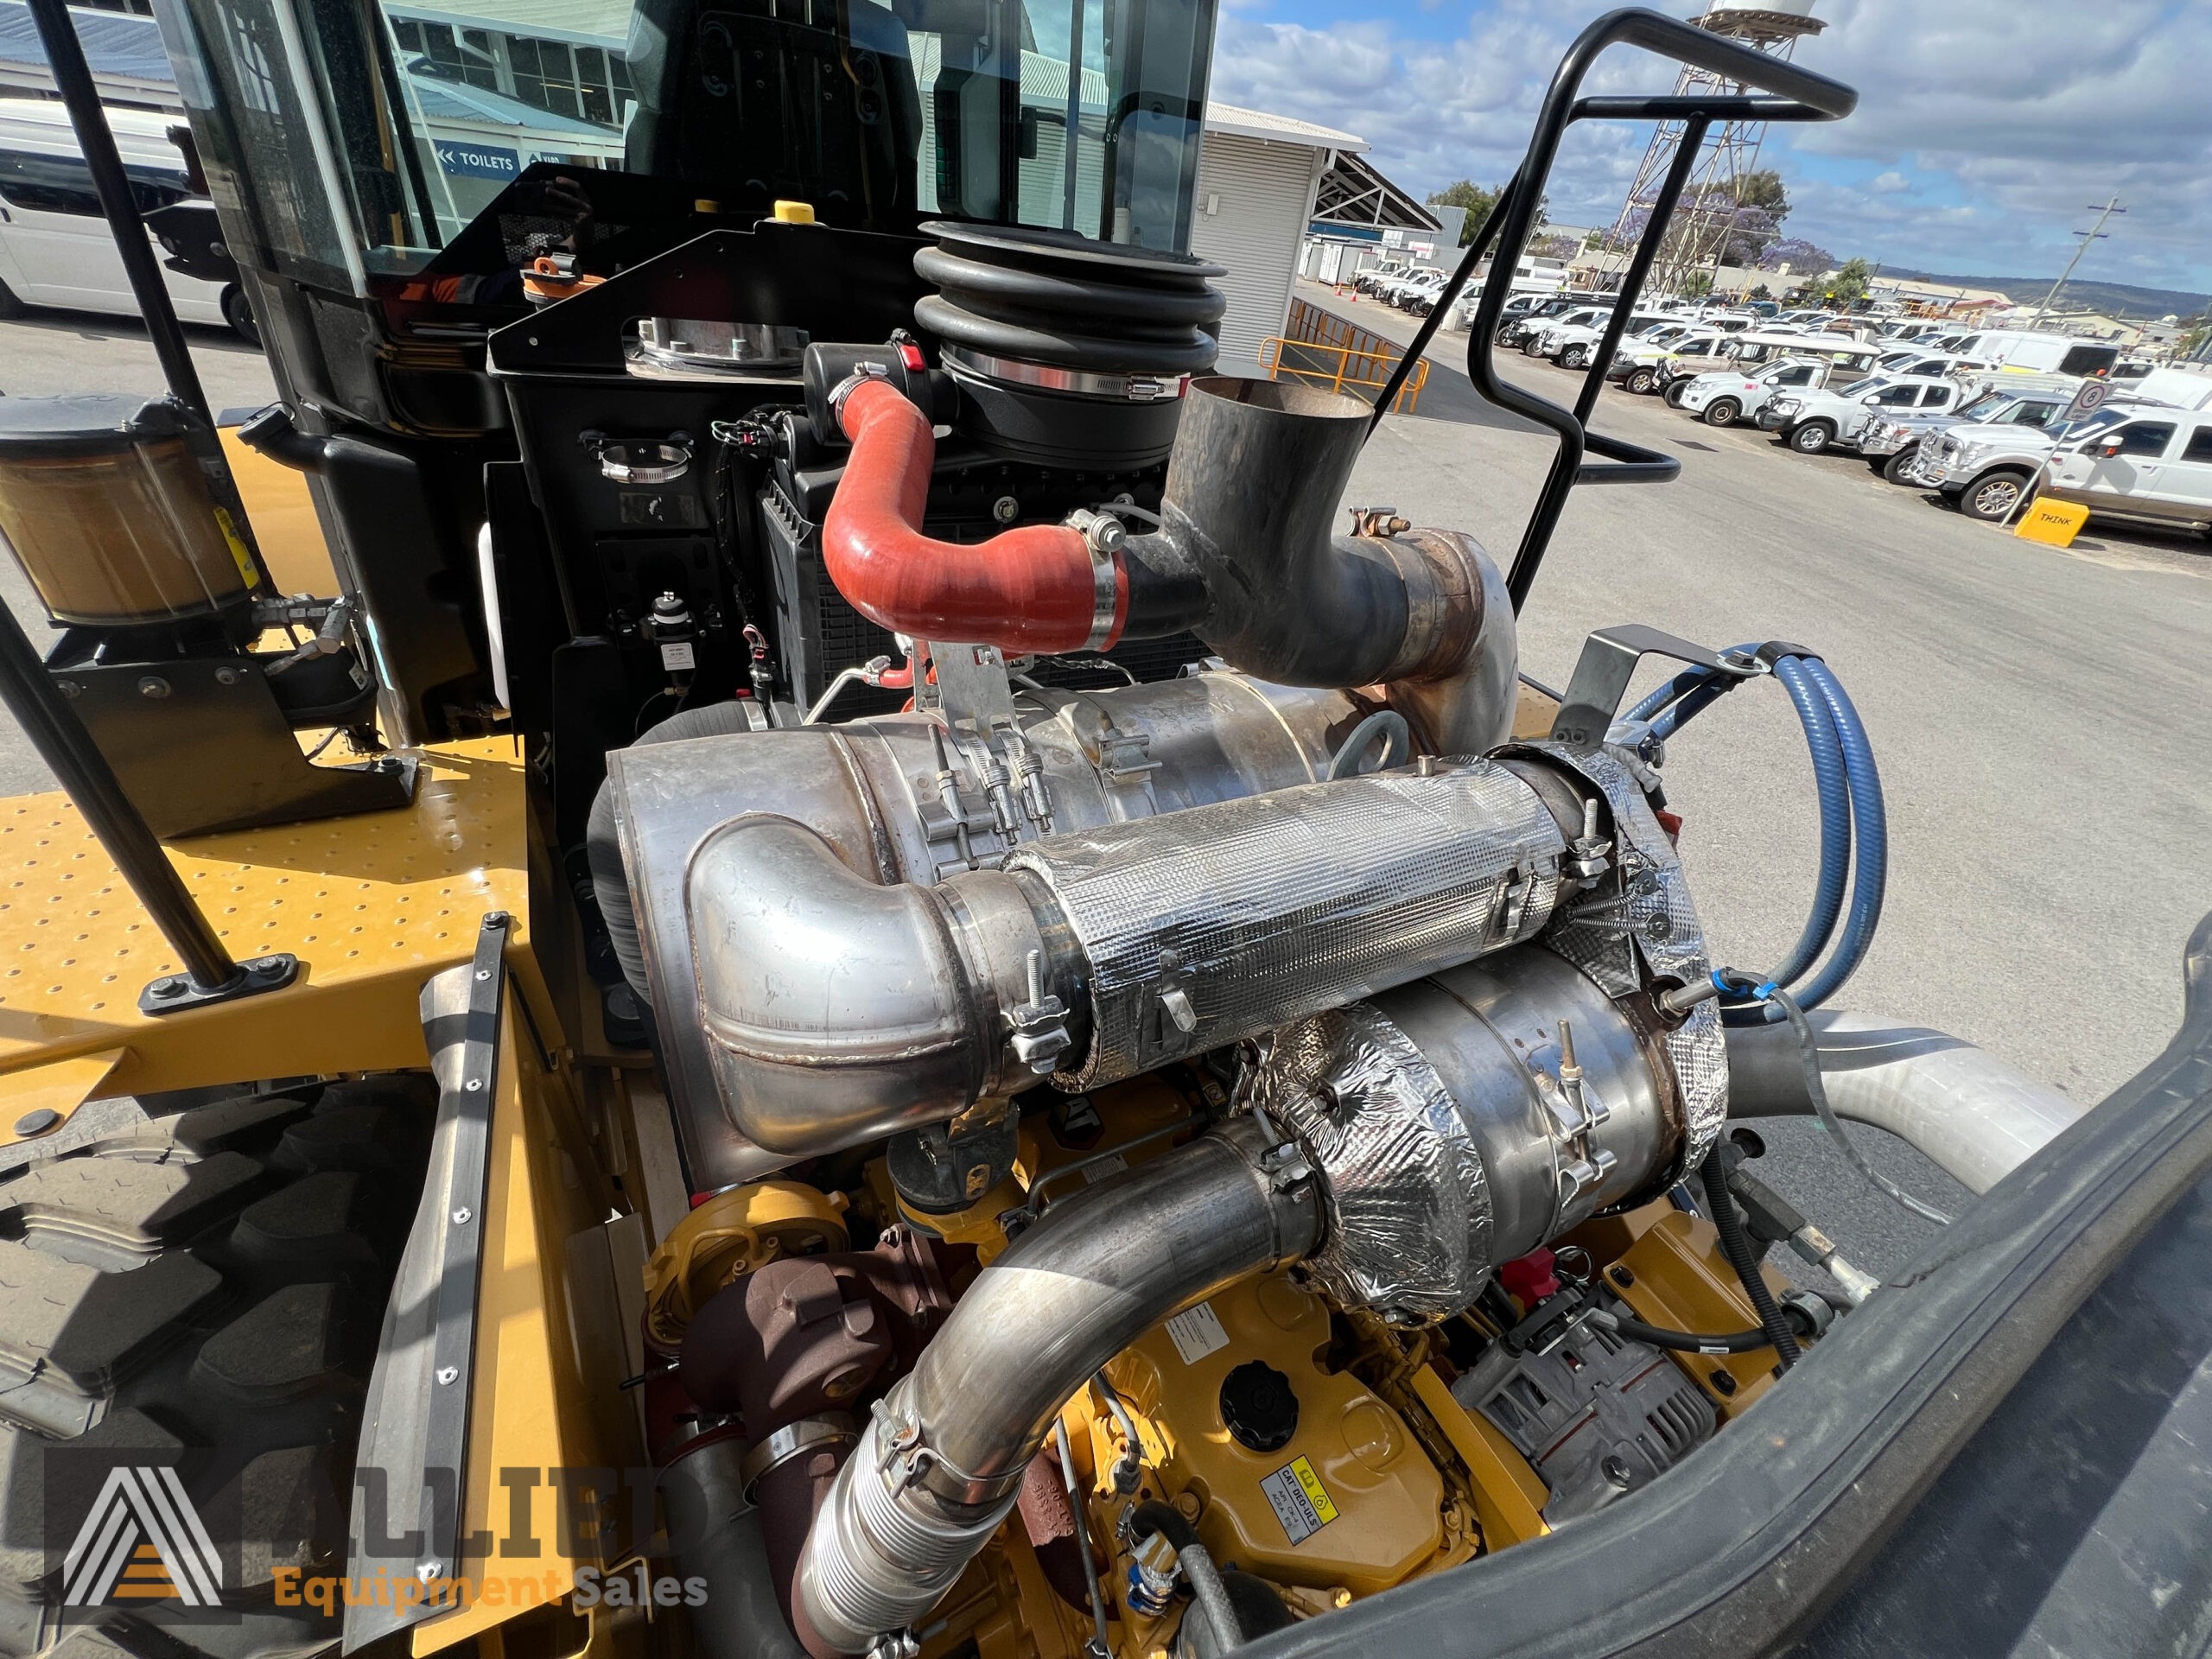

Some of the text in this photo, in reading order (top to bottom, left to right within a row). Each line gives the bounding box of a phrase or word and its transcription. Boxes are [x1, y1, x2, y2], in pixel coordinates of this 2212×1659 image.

[459, 152, 514, 171] TOILETS
[2088, 391, 2097, 403] 8
[2040, 512, 2072, 525] THINK
[1065, 1097, 1101, 1132] AT
[1279, 1490, 1287, 1503] API
[1293, 1488, 1317, 1526] DEO-ULS
